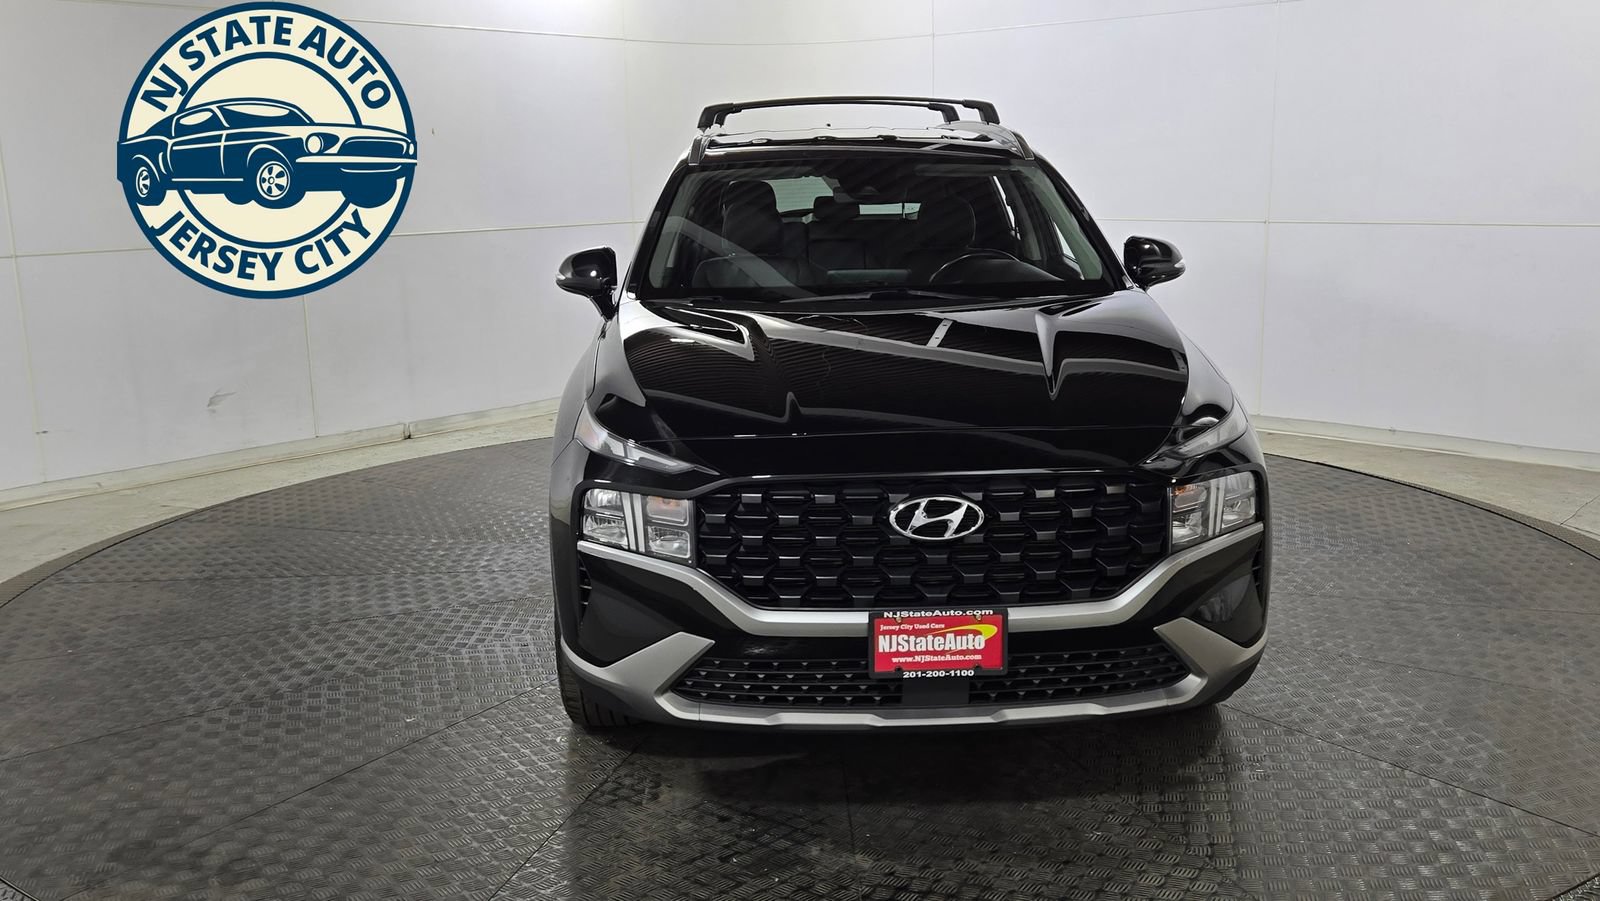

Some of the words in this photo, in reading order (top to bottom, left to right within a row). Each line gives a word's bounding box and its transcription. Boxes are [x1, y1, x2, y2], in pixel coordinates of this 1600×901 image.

[883, 609, 993, 618] NJStateAuto.com
[878, 633, 985, 653] NJStateAuto
[892, 654, 982, 663] www.NJStateAuto.com
[903, 670, 974, 678] 201-200-1100
